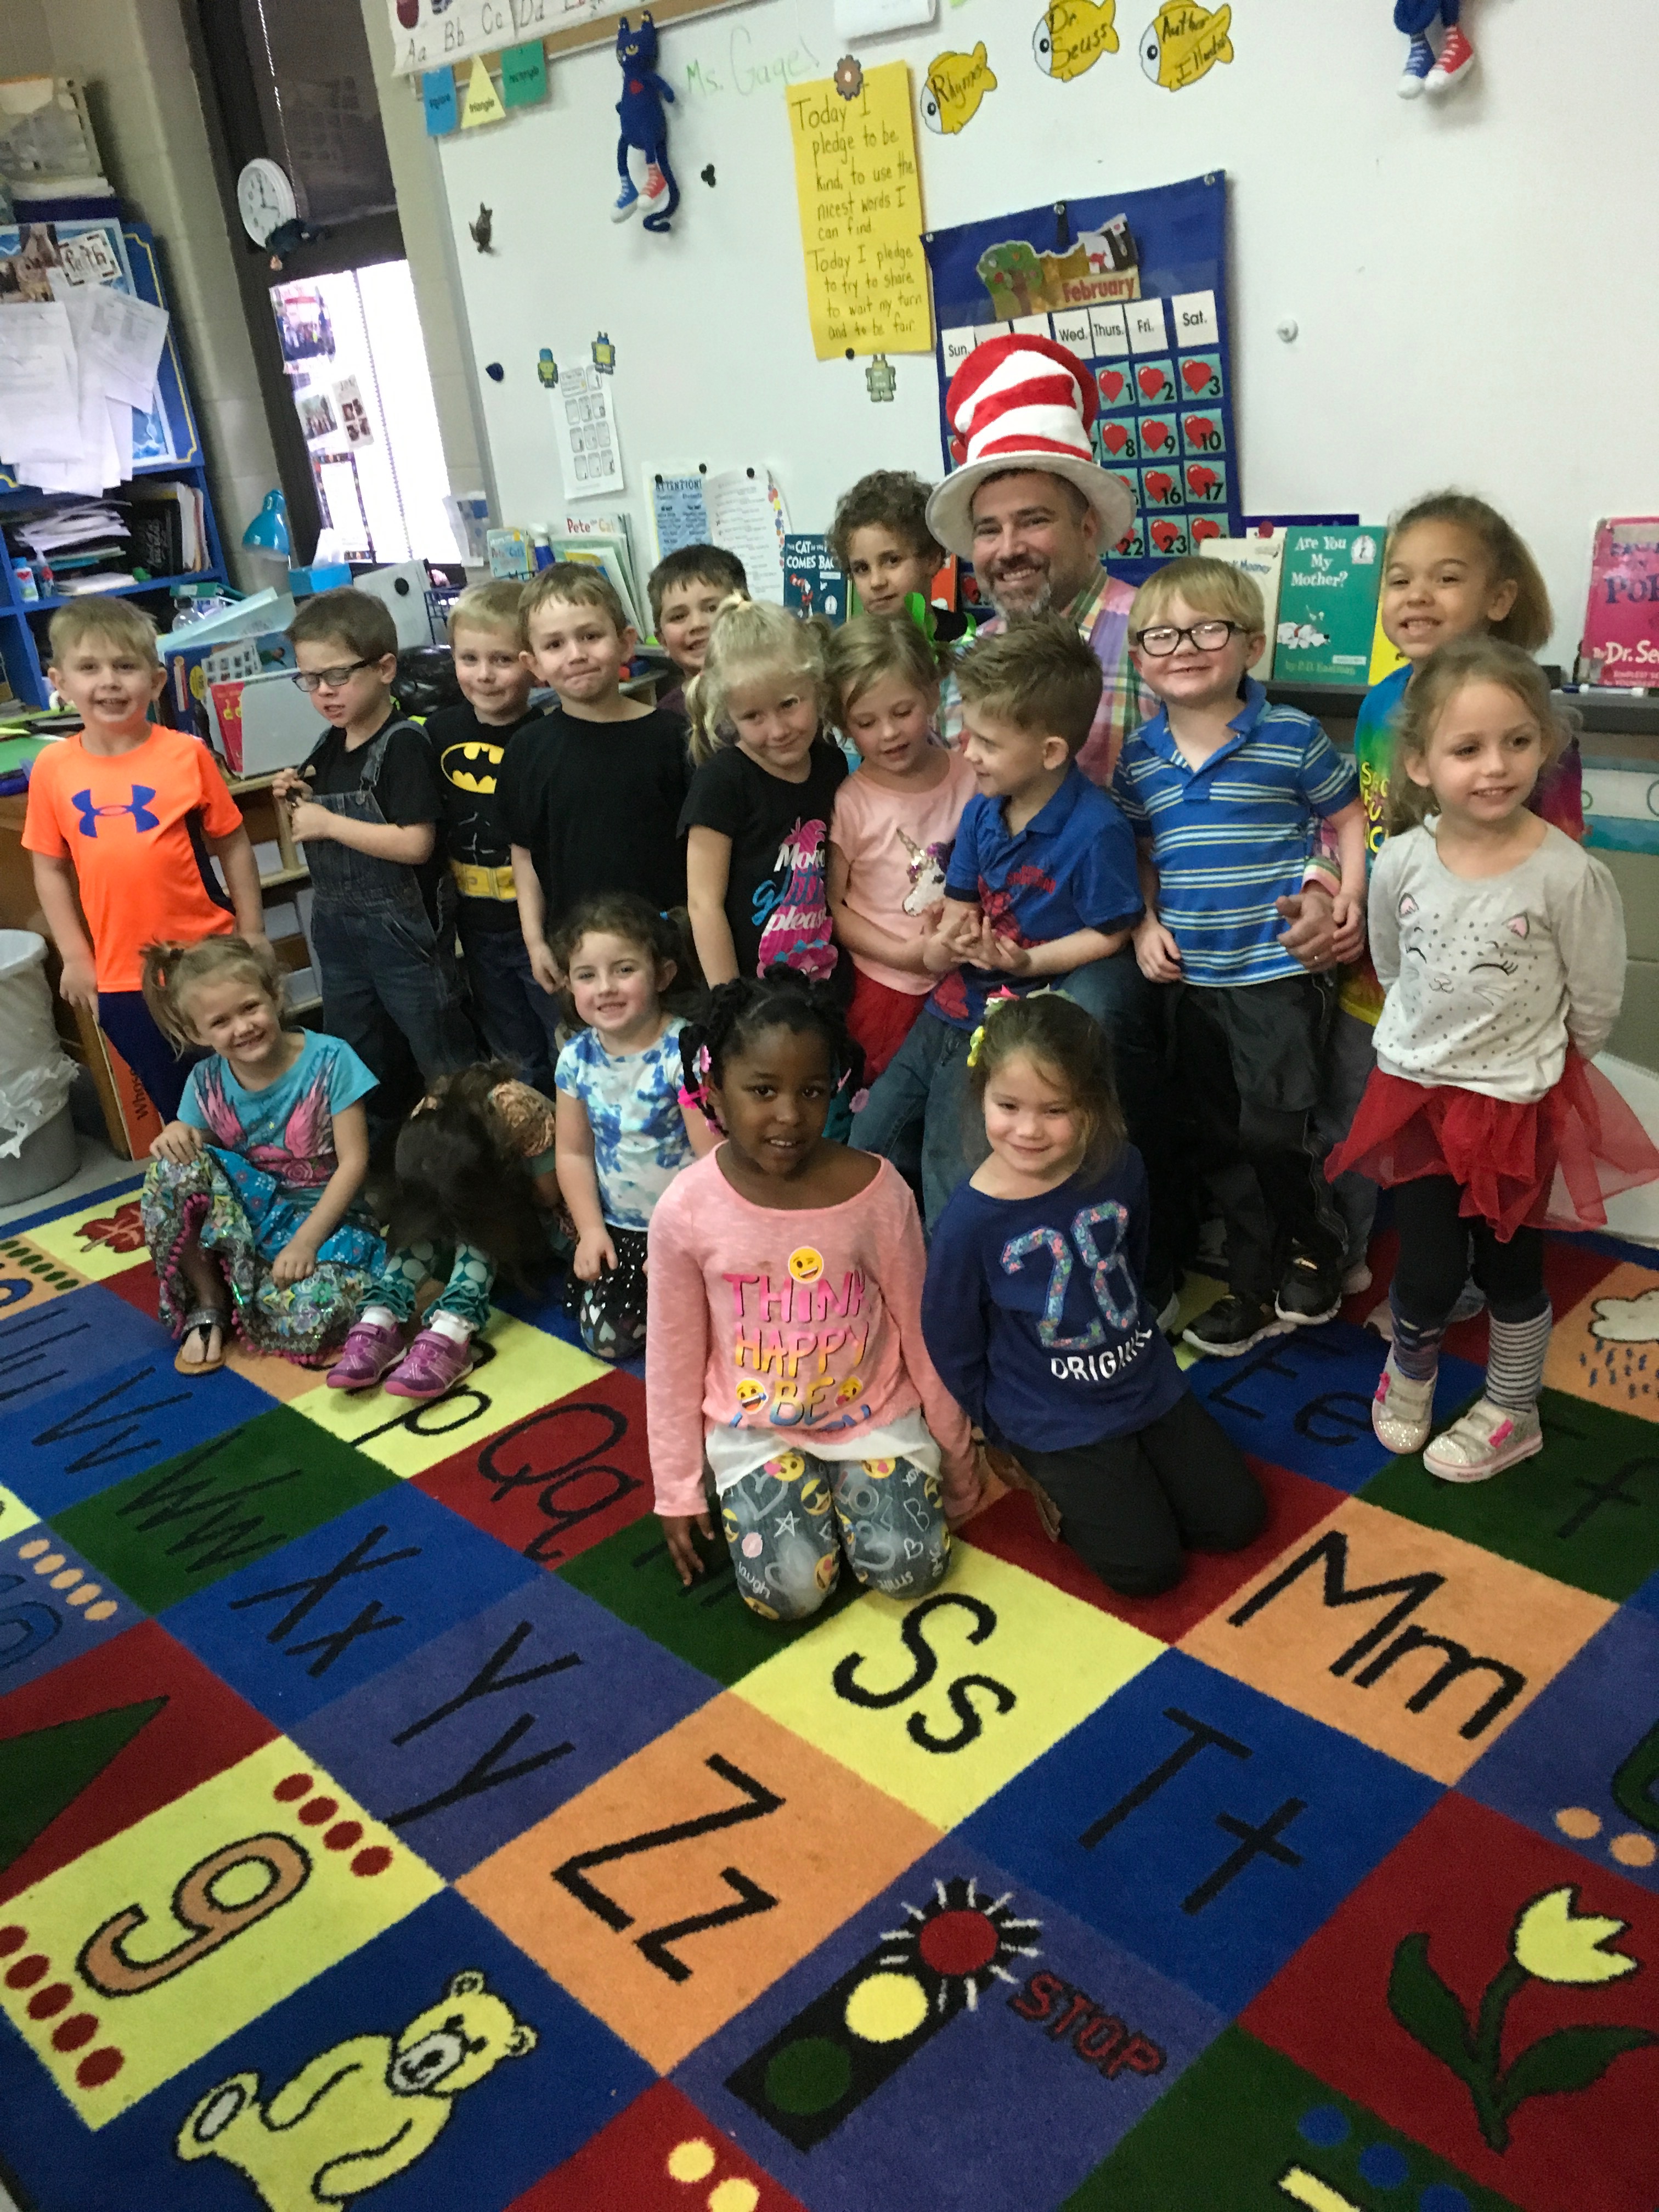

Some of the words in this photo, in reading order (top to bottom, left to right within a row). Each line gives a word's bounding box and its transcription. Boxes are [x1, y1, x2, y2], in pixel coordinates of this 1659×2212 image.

[445, 17, 464, 52] Bb
[1051, 22, 1108, 71] Seuss
[791, 94, 847, 131] Today
[861, 83, 871, 117] I
[812, 131, 854, 165] pledge
[863, 125, 876, 147] to
[883, 120, 899, 145] be
[851, 157, 865, 185] to
[874, 167, 892, 182] use
[898, 150, 914, 178] the
[817, 191, 854, 221] nicest
[862, 190, 890, 212] words
[895, 185, 906, 207] I
[819, 227, 838, 241] can
[807, 247, 850, 276] Today
[857, 244, 866, 263] I
[877, 240, 913, 270] pledge
[825, 276, 837, 293] to
[842, 274, 857, 298] try
[866, 272, 877, 289] to
[884, 268, 914, 288] share
[1063, 275, 1135, 303] February
[827, 298, 839, 318] to
[850, 296, 872, 315] wait
[880, 300, 891, 317] my
[898, 290, 921, 306] turn
[828, 323, 847, 340] and
[855, 321, 866, 336] to
[873, 318, 885, 336] be
[948, 344, 970, 357] Sun.
[1059, 329, 1087, 342] Wed.
[1093, 323, 1124, 337] Thurs.
[1137, 321, 1154, 334] Fri.
[1183, 312, 1208, 327] Sat.
[1126, 383, 1134, 402] 1
[1162, 381, 1175, 402] 2
[1209, 375, 1221, 396] 3
[1125, 439, 1136, 458] 8
[1164, 435, 1176, 455] 9
[1200, 431, 1222, 452] 10
[1161, 487, 1182, 505] 16
[1204, 482, 1223, 501] 17
[567, 517, 590, 533] Pete
[1295, 536, 1319, 551] Are
[1323, 535, 1347, 550] You
[787, 555, 816, 569] COMES
[818, 555, 838, 570] BAC
[795, 540, 811, 554] CAT
[1121, 538, 1143, 556] 22
[1163, 535, 1188, 554] 23
[1311, 553, 1334, 572] My
[1291, 571, 1348, 588] Mother?
[1605, 641, 1633, 665] Dr.
[1000, 1199, 1138, 1350] 28
[735, 1321, 869, 1378] HAPPY
[769, 1376, 835, 1426] BE
[478, 1402, 645, 1561] Qq
[738, 1561, 770, 1599] laugh
[229, 1525, 422, 1678] Xx
[1227, 1530, 1528, 1740] Mm
[833, 1592, 1016, 1754] Ss
[383, 1620, 584, 1829] Yy
[1079, 1707, 1308, 1916] Tt
[550, 1753, 786, 1984] Zz
[75, 1831, 312, 1998] 9
[1007, 1971, 1167, 2083] STOP
